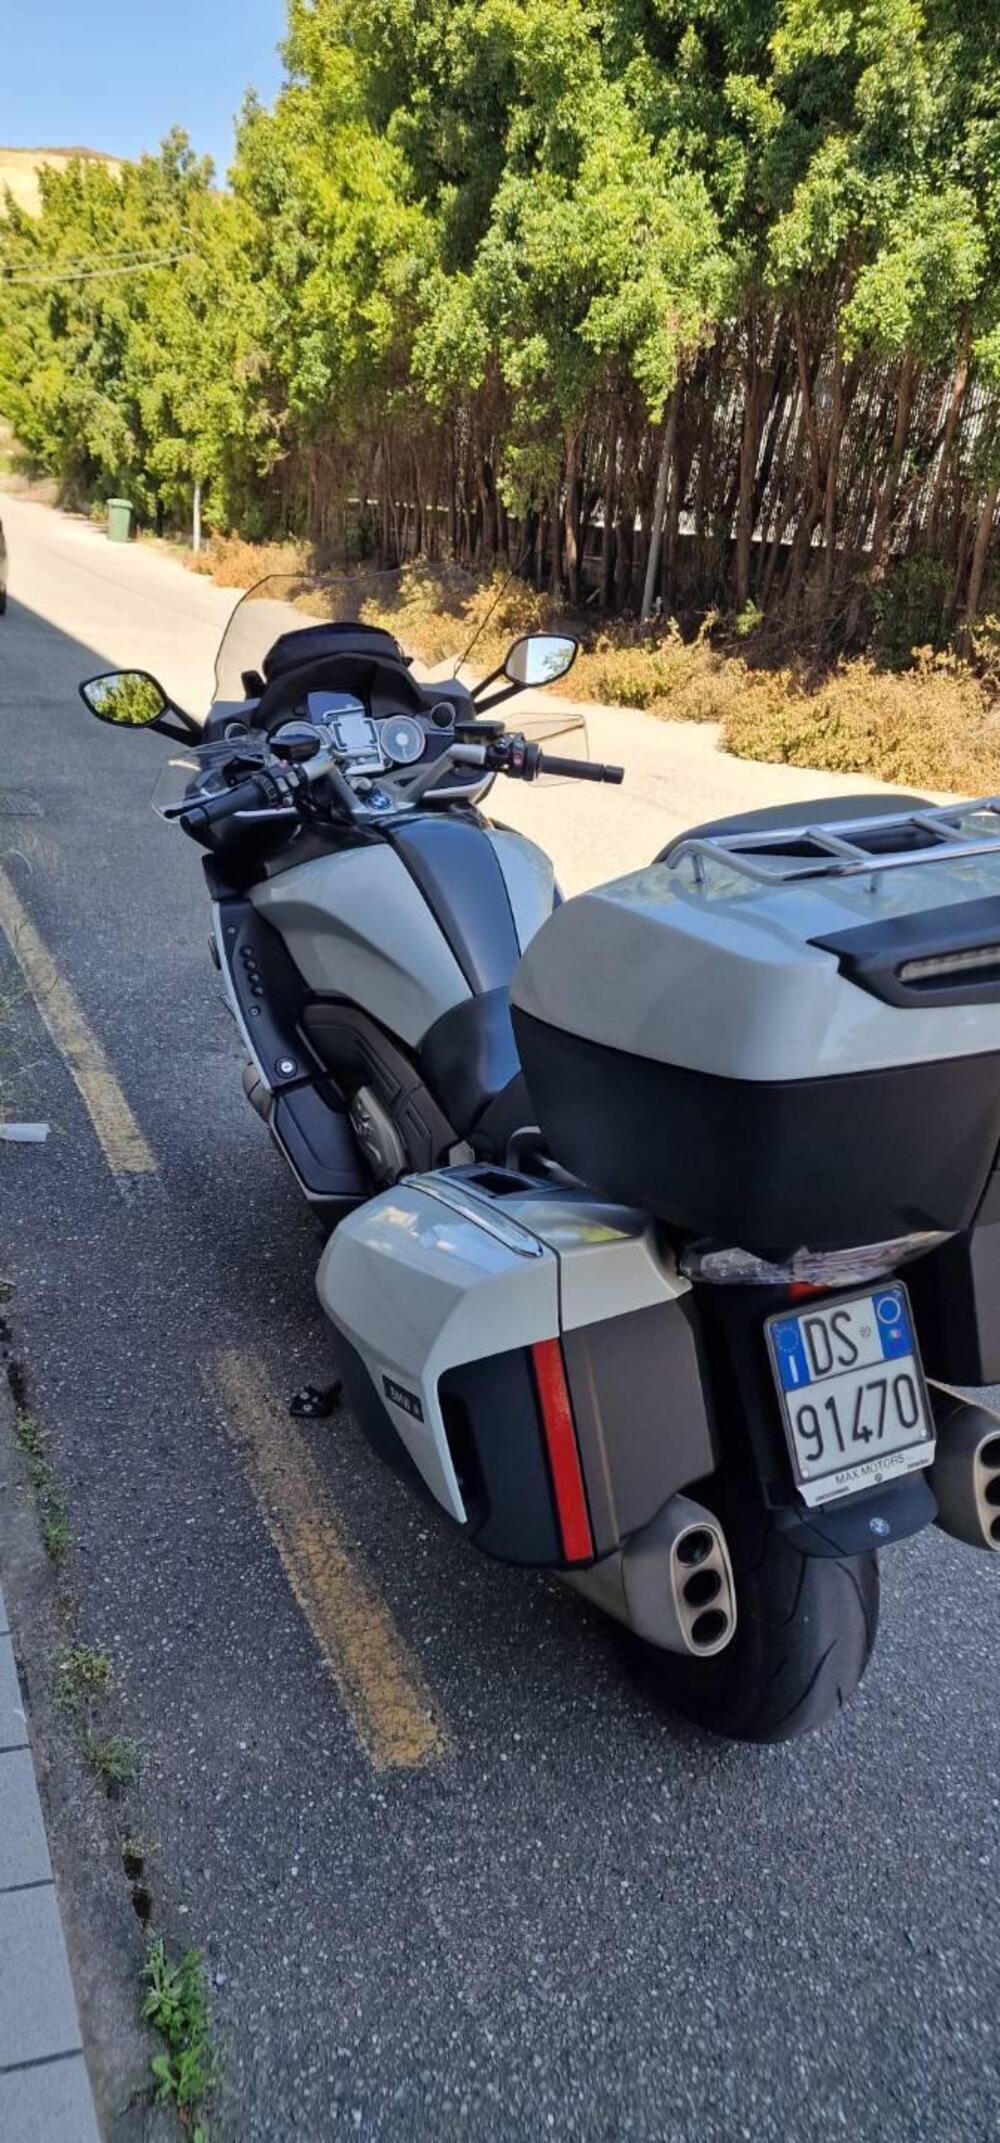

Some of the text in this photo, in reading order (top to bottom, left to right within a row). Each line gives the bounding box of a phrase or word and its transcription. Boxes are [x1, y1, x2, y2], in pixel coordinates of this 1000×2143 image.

[803, 1311, 858, 1376] DS
[789, 1355, 799, 1383] I
[796, 1373, 919, 1461] 91470
[835, 1470, 859, 1485] MAX
[861, 1454, 905, 1476] MOTORS
